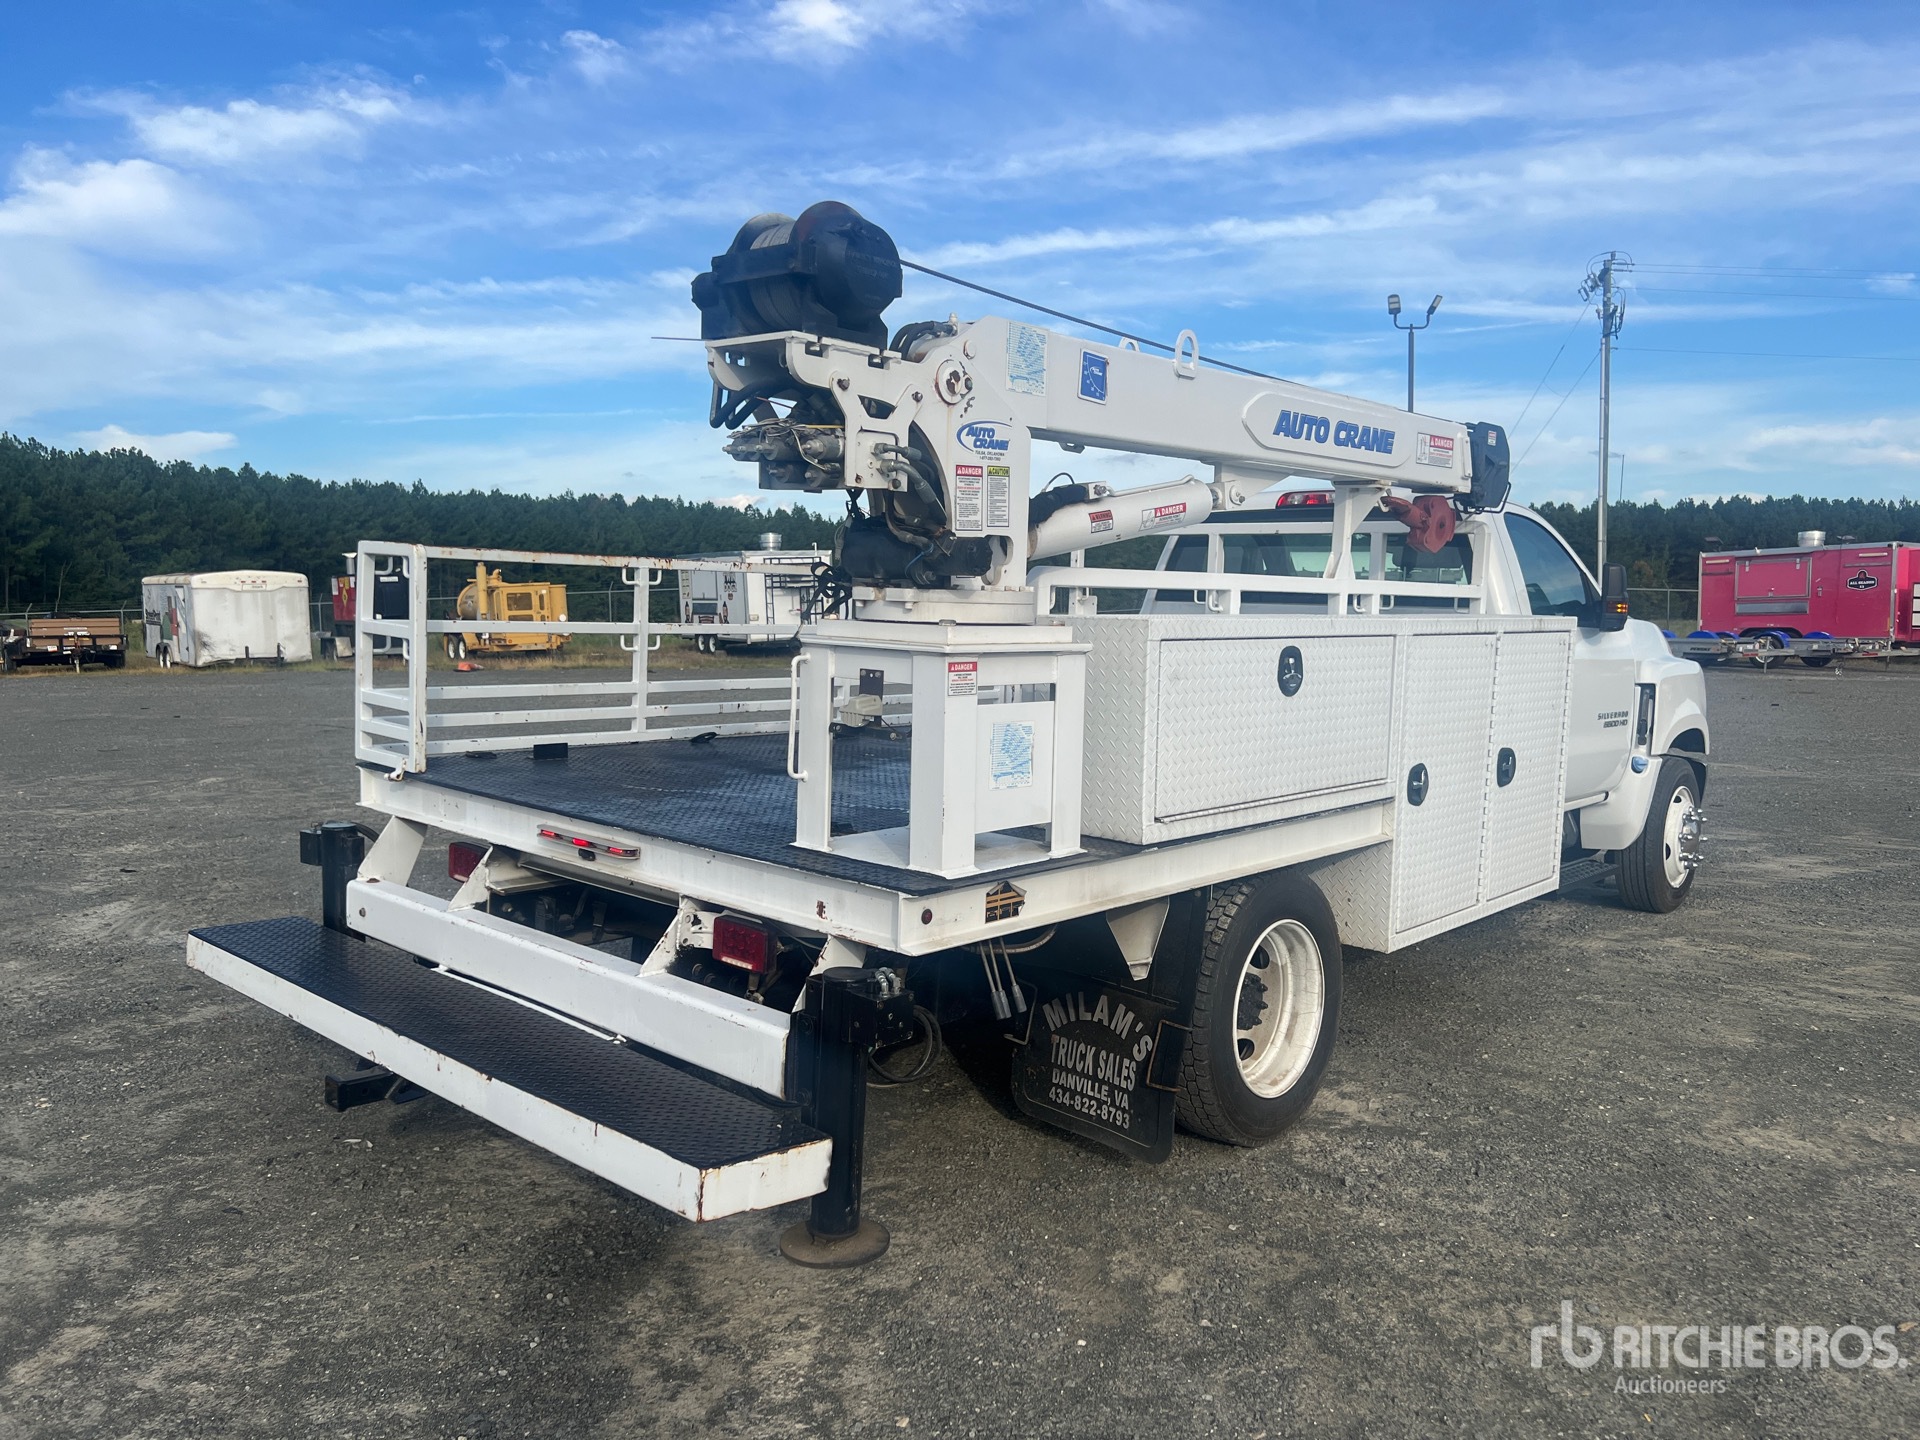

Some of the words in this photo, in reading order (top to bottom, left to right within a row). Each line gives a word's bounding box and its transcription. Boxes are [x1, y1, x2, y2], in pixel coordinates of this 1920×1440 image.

[965, 426, 996, 439] AUTO
[1273, 409, 1330, 444] AUTO
[1333, 420, 1396, 454] CRANE
[973, 438, 1009, 451] CRANE
[1435, 437, 1453, 449] DANGER
[962, 467, 982, 475] DANGER
[1161, 504, 1184, 516] DANGER
[954, 663, 973, 671] DANGER
[1597, 711, 1629, 720] SILVERADO
[1042, 991, 1153, 1062] MILAM'S
[1050, 1034, 1096, 1076] TRUCK
[1097, 1049, 1137, 1092] SALES
[1052, 1068, 1111, 1106] DANVILLE,
[1114, 1090, 1129, 1110] VA
[1049, 1086, 1130, 1129] 434-822-8793
